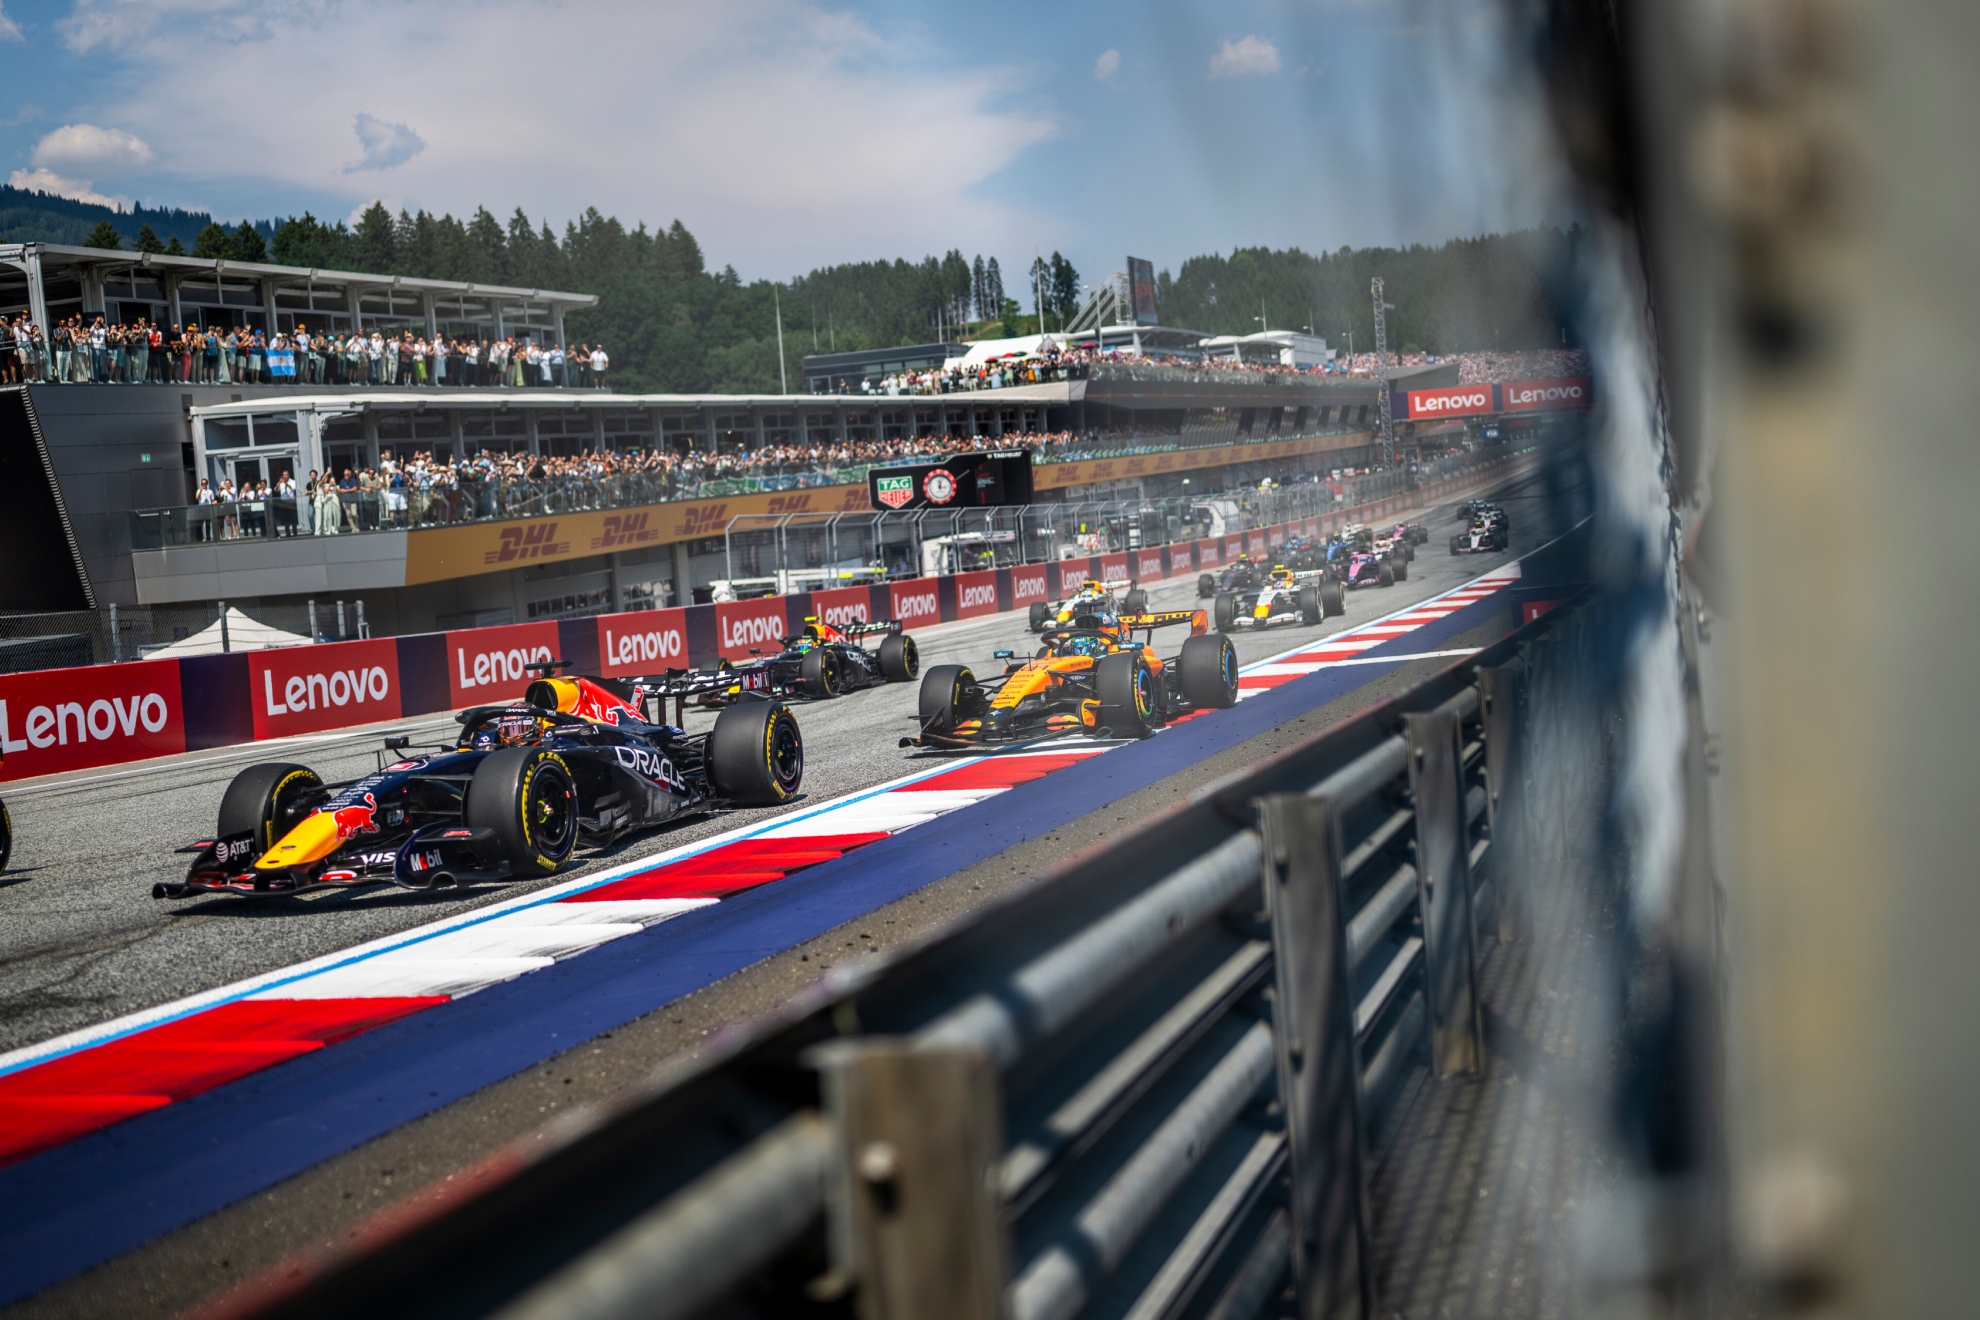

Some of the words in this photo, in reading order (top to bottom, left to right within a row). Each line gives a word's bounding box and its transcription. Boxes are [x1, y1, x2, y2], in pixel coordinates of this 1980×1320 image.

[1414, 393, 1486, 412] Lenovo
[1509, 386, 1582, 404] Lenovo
[881, 478, 909, 490] TAG
[879, 490, 913, 509] HEUER
[601, 512, 651, 547] DHL
[682, 504, 728, 535] DHL
[497, 522, 560, 563] DHL
[1102, 562, 1127, 582] Lenovo
[1138, 557, 1161, 577] Lenovo
[1013, 576, 1045, 599] Lenovo
[1062, 568, 1089, 591] Lenovo
[894, 592, 937, 619] Lenovo
[959, 584, 995, 608] Lenovo
[722, 615, 783, 649] Lenovo
[606, 629, 681, 666] Lenovo
[458, 645, 551, 690] Lenovo
[264, 665, 389, 717] Lenovo
[742, 673, 762, 690] Mobil
[0, 692, 168, 754] Lenovo
[538, 751, 546, 762] P
[614, 745, 686, 791] ORACLE
[229, 839, 251, 857] AT&T
[360, 852, 396, 864] VIS
[410, 848, 443, 872] Mobil
